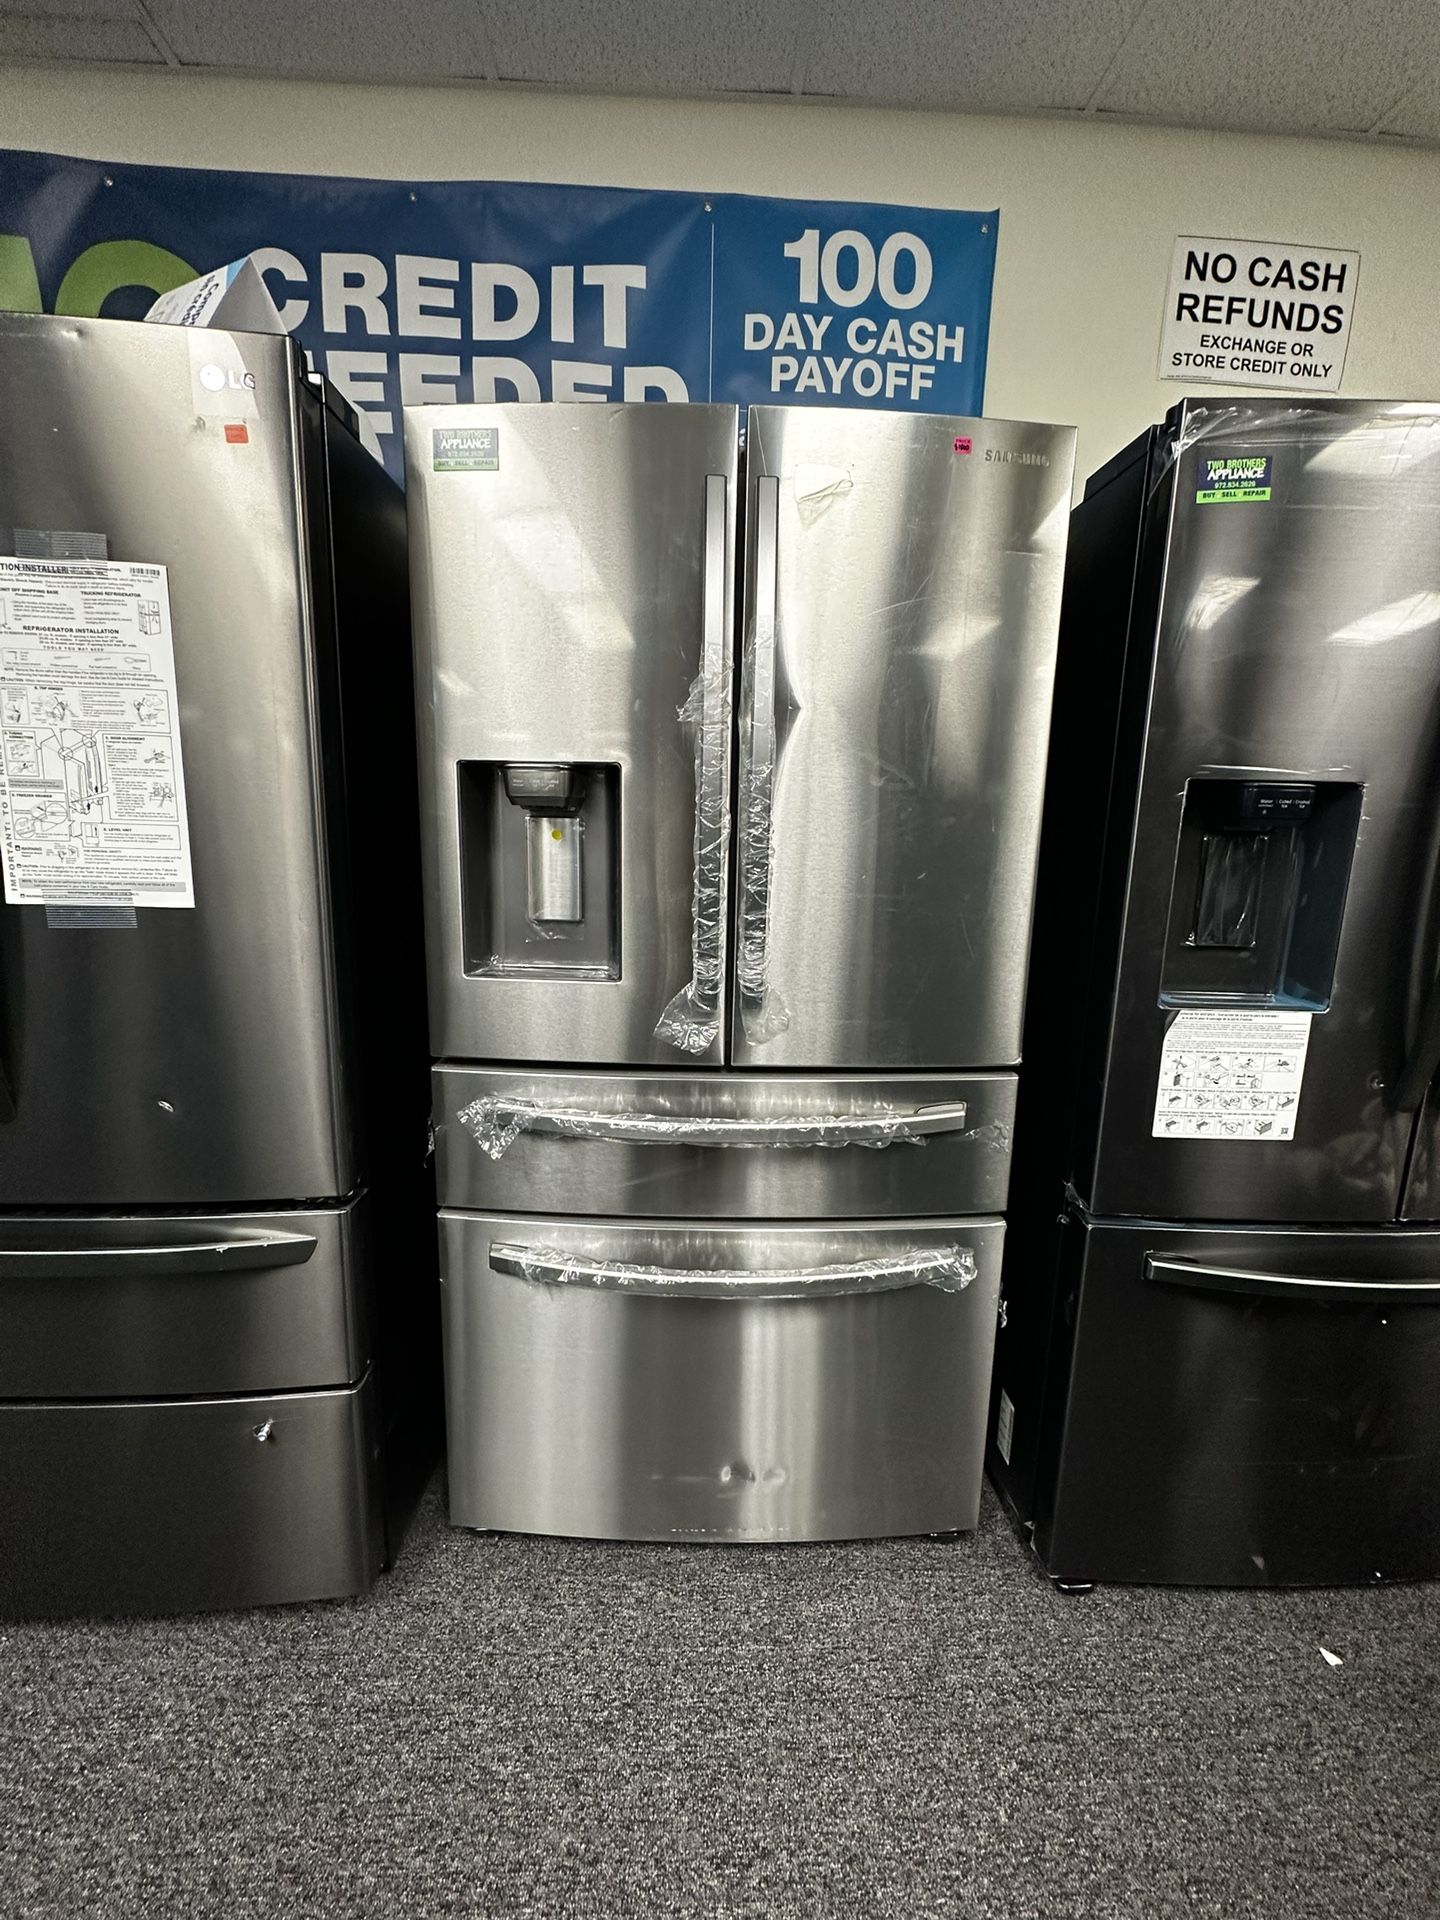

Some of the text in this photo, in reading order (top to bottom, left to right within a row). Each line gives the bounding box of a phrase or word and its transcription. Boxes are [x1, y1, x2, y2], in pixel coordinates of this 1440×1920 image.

[783, 229, 933, 310] 100
[1184, 250, 1348, 294] NO CASH
[247, 247, 647, 349] CREDIT
[1175, 292, 1344, 335] REFUNDS
[744, 312, 965, 363] DAY CASH
[1200, 334, 1314, 358] EXCHANGE OR
[1171, 352, 1333, 378] STORE CREDIT ONLY
[228, 369, 256, 390] LG
[770, 355, 936, 401] PAYOFF
[303, 351, 690, 434] EEDED
[440, 438, 492, 450] APPLIANCE
[1206, 467, 1265, 481] APPLIANCE
[1207, 457, 1267, 470] TWO BROTHERS
[1243, 489, 1266, 497] REPAIR
[22, 625, 119, 635] REFRIGERATOR INSTALLATION
[0, 781, 7, 796] BE
[2, 801, 9, 817] TO
[4, 821, 18, 892] IMPORTANT:
